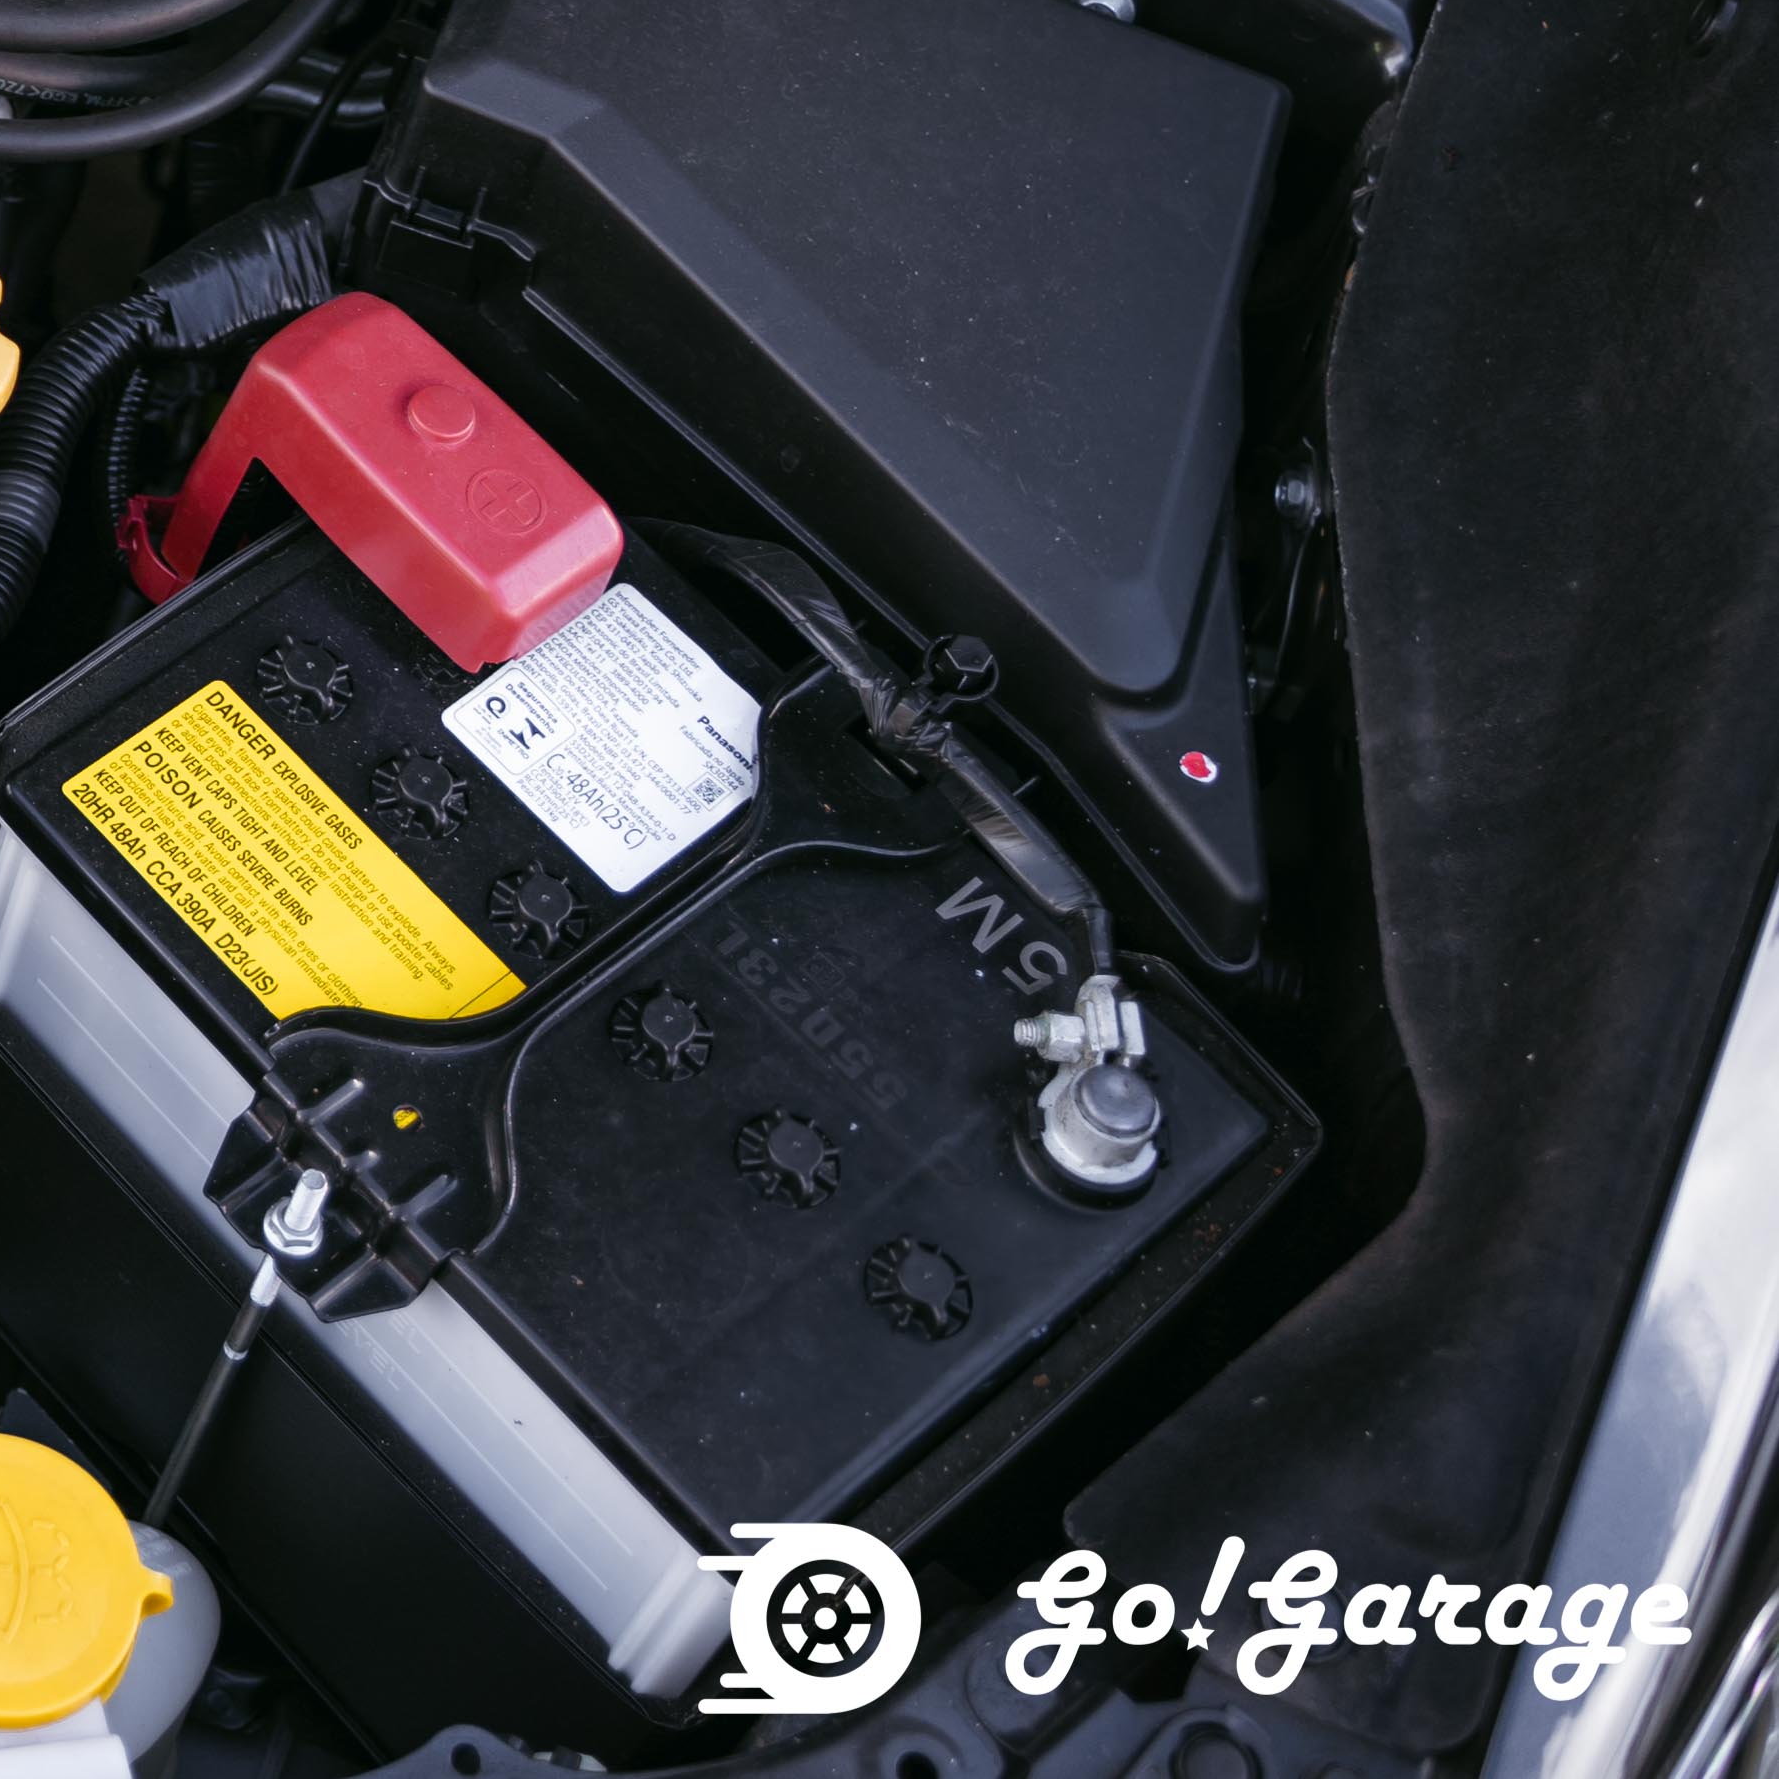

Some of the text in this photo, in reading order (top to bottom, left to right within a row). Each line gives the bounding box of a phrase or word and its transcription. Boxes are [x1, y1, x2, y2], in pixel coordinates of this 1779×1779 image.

[132, 740, 313, 926] POISON CAUSES SEVERE BURNS
[154, 727, 318, 896] KEEP VENT CAPS TIGHT AND LEVEL
[192, 703, 455, 974] Cigarettes, flames or sparks could cause battery to explode. Always
[206, 692, 362, 849] DANGER EXPLOSIVE GASES
[696, 715, 755, 772] Panasoni
[71, 783, 278, 995] 20HR 48Ah CCA 390A D23(JIS)
[93, 768, 256, 937] KEEP OUT OF REACH OF CHILDREN
[108, 761, 123, 772] of
[118, 772, 155, 807] accident
[152, 806, 175, 829] flush
[173, 828, 194, 850] with
[193, 849, 220, 875] water
[217, 876, 238, 893] and
[233, 892, 253, 909] call
[249, 908, 258, 917] a
[255, 916, 297, 957] physician
[119, 753, 155, 790] Contains
[152, 789, 185, 822] sulfuric
[202, 842, 231, 867] Avoid
[227, 867, 260, 901] contact
[252, 898, 279, 920] with
[296, 940, 319, 963] eyes
[316, 962, 329, 972] or
[170, 719, 423, 981] or adjust post connections without proper instruction and training.
[181, 711, 453, 990] shield eyes and face from battery. Do not charge or use booster cables
[935, 876, 1068, 996] 5M
